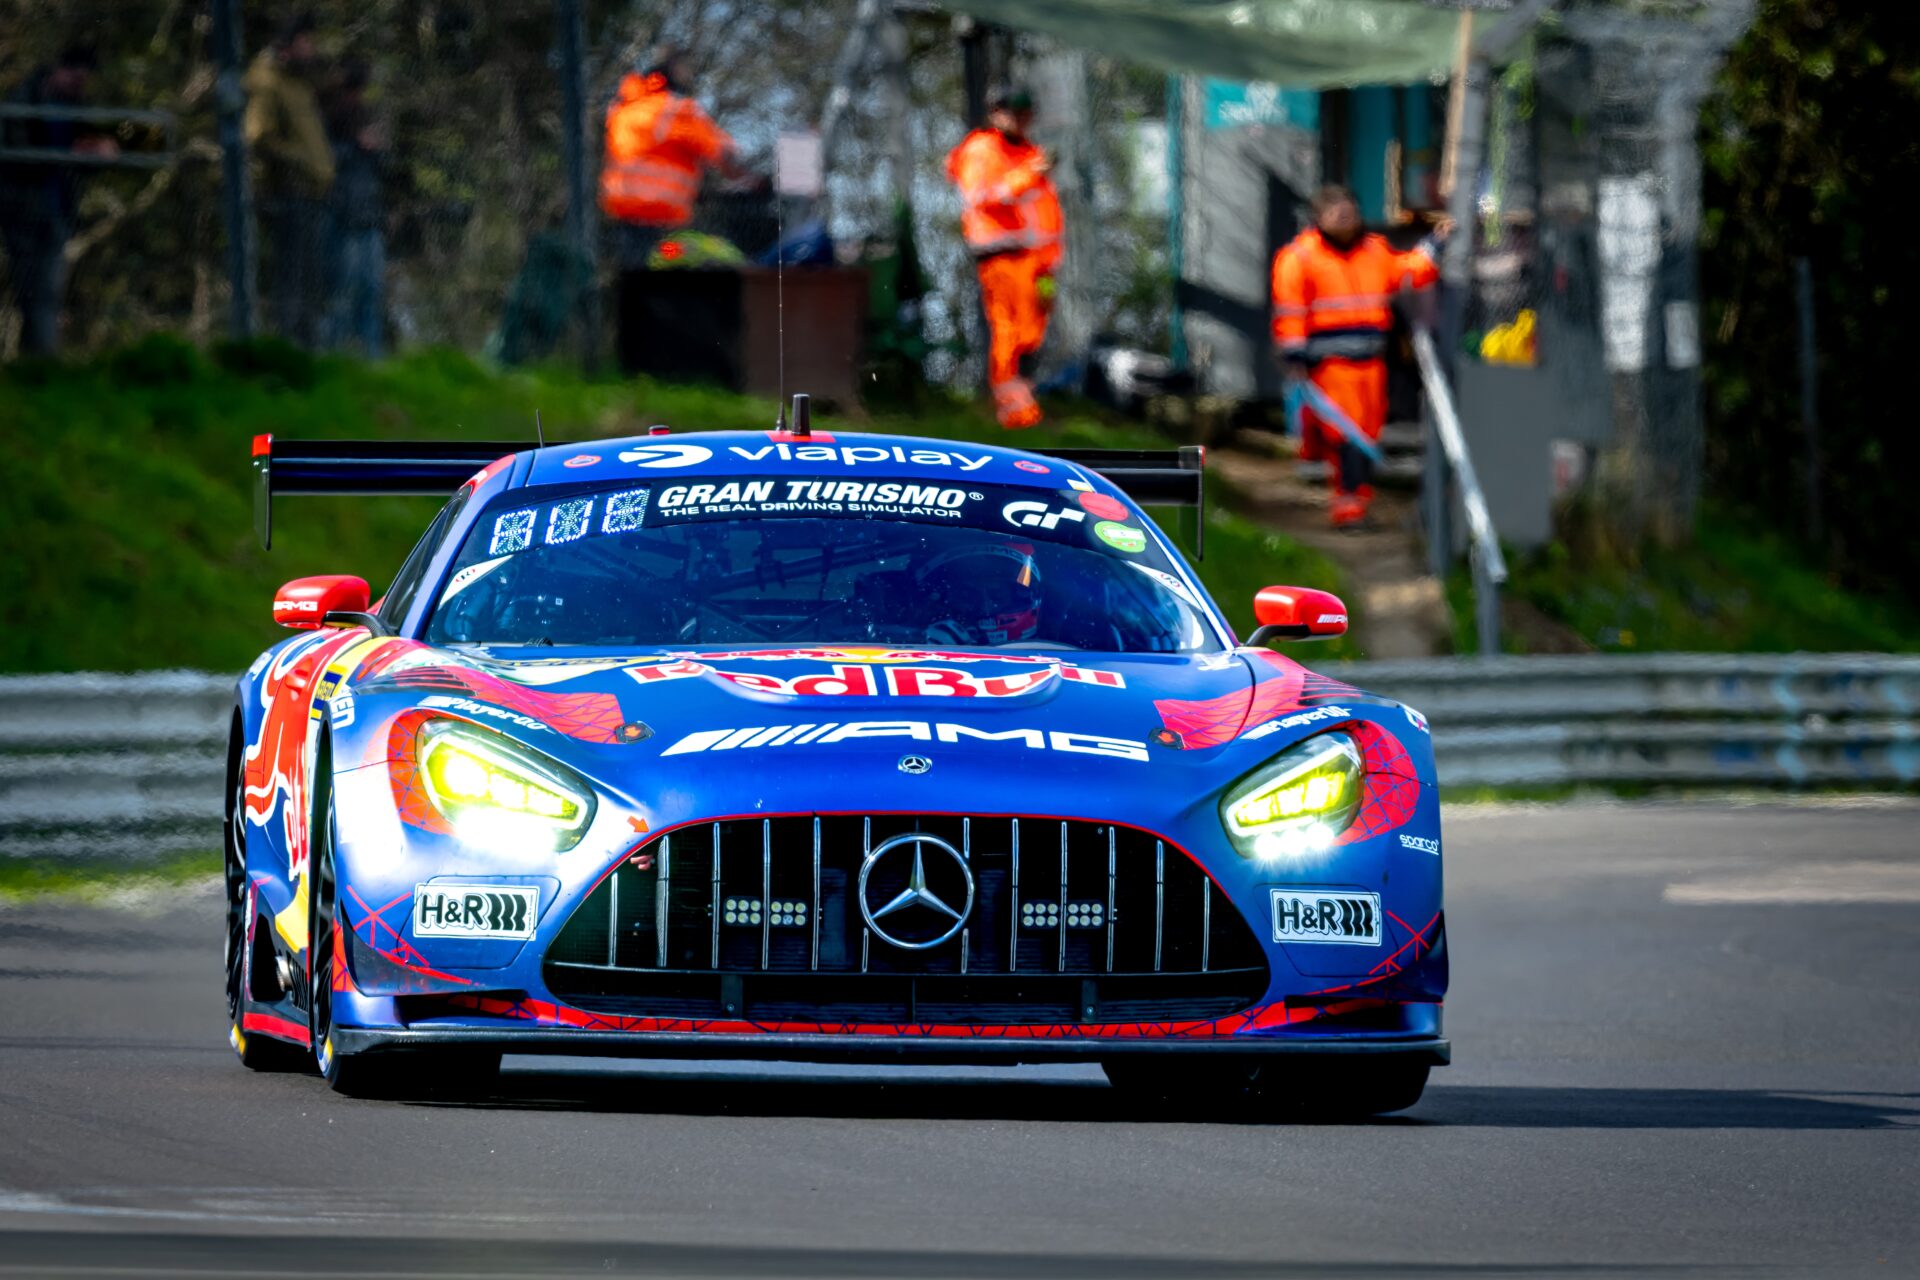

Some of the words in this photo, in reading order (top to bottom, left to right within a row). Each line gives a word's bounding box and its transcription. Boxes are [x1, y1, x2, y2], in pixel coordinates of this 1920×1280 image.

[728, 443, 993, 471] viaplay
[658, 481, 775, 508] GRAN
[660, 506, 699, 517] THE
[705, 503, 757, 513] REAL
[760, 502, 843, 512] DRIVING
[848, 503, 962, 518] SIMULATOR
[622, 659, 878, 697] Red
[884, 663, 1127, 698] Bull
[815, 721, 1150, 762] AMG
[1399, 834, 1438, 852] sparco
[420, 894, 486, 927] H&R
[1277, 899, 1338, 932] H&R
